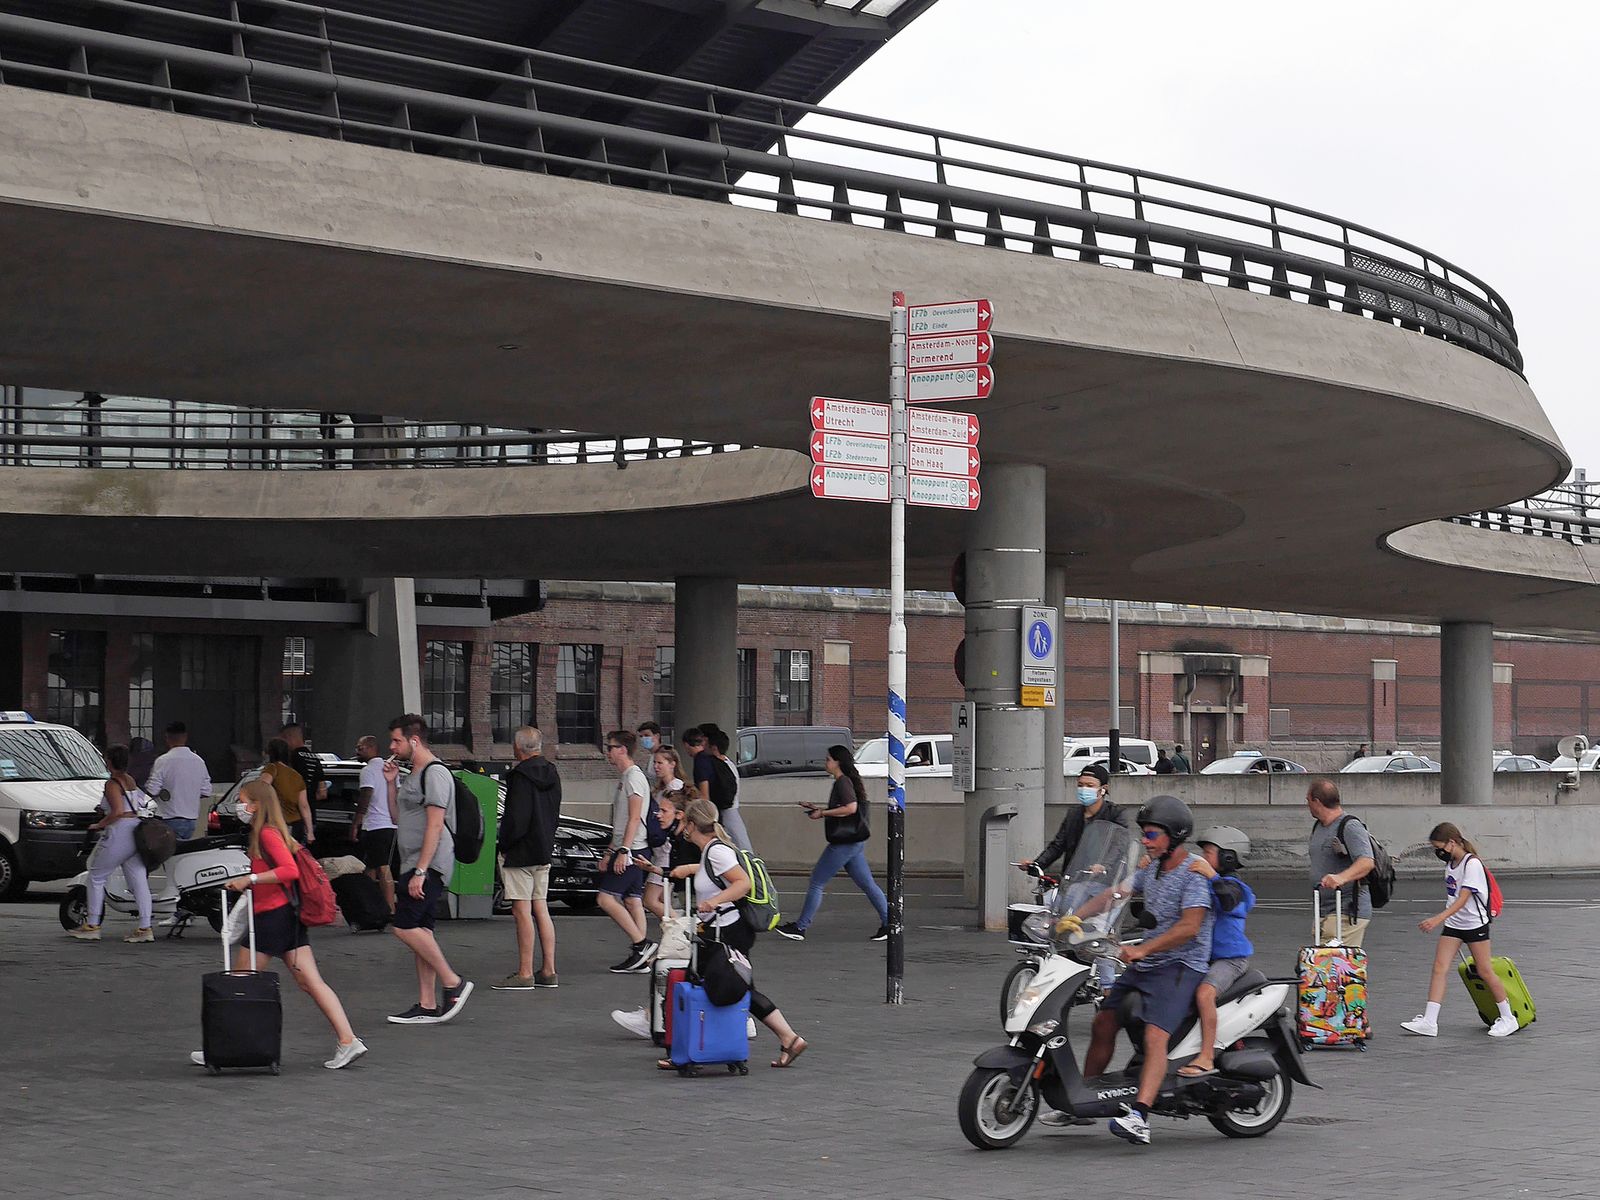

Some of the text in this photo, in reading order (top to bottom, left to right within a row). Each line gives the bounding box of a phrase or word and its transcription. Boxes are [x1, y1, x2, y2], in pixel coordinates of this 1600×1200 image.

[911, 308, 928, 318] LF7b
[911, 322, 928, 331] LF2b
[911, 338, 976, 350] Amsterdam-Noord
[911, 353, 954, 363] Purmerend
[911, 372, 954, 383] Knooppunt
[826, 403, 887, 417] Amsterdam-Oost
[825, 416, 854, 427] Utrecht
[911, 411, 967, 425] Amsterdam-West
[911, 424, 967, 439] Amsterdam-Zuid
[825, 436, 842, 445] LF7b
[825, 449, 842, 459] LF2b
[911, 443, 943, 455] Zaanstad
[911, 457, 943, 471] Den Haag
[826, 469, 866, 481] Knooppunt
[911, 476, 949, 488] Knooppunt
[911, 490, 949, 502] Knooppunt
[1097, 1086, 1138, 1100] KYMCO
